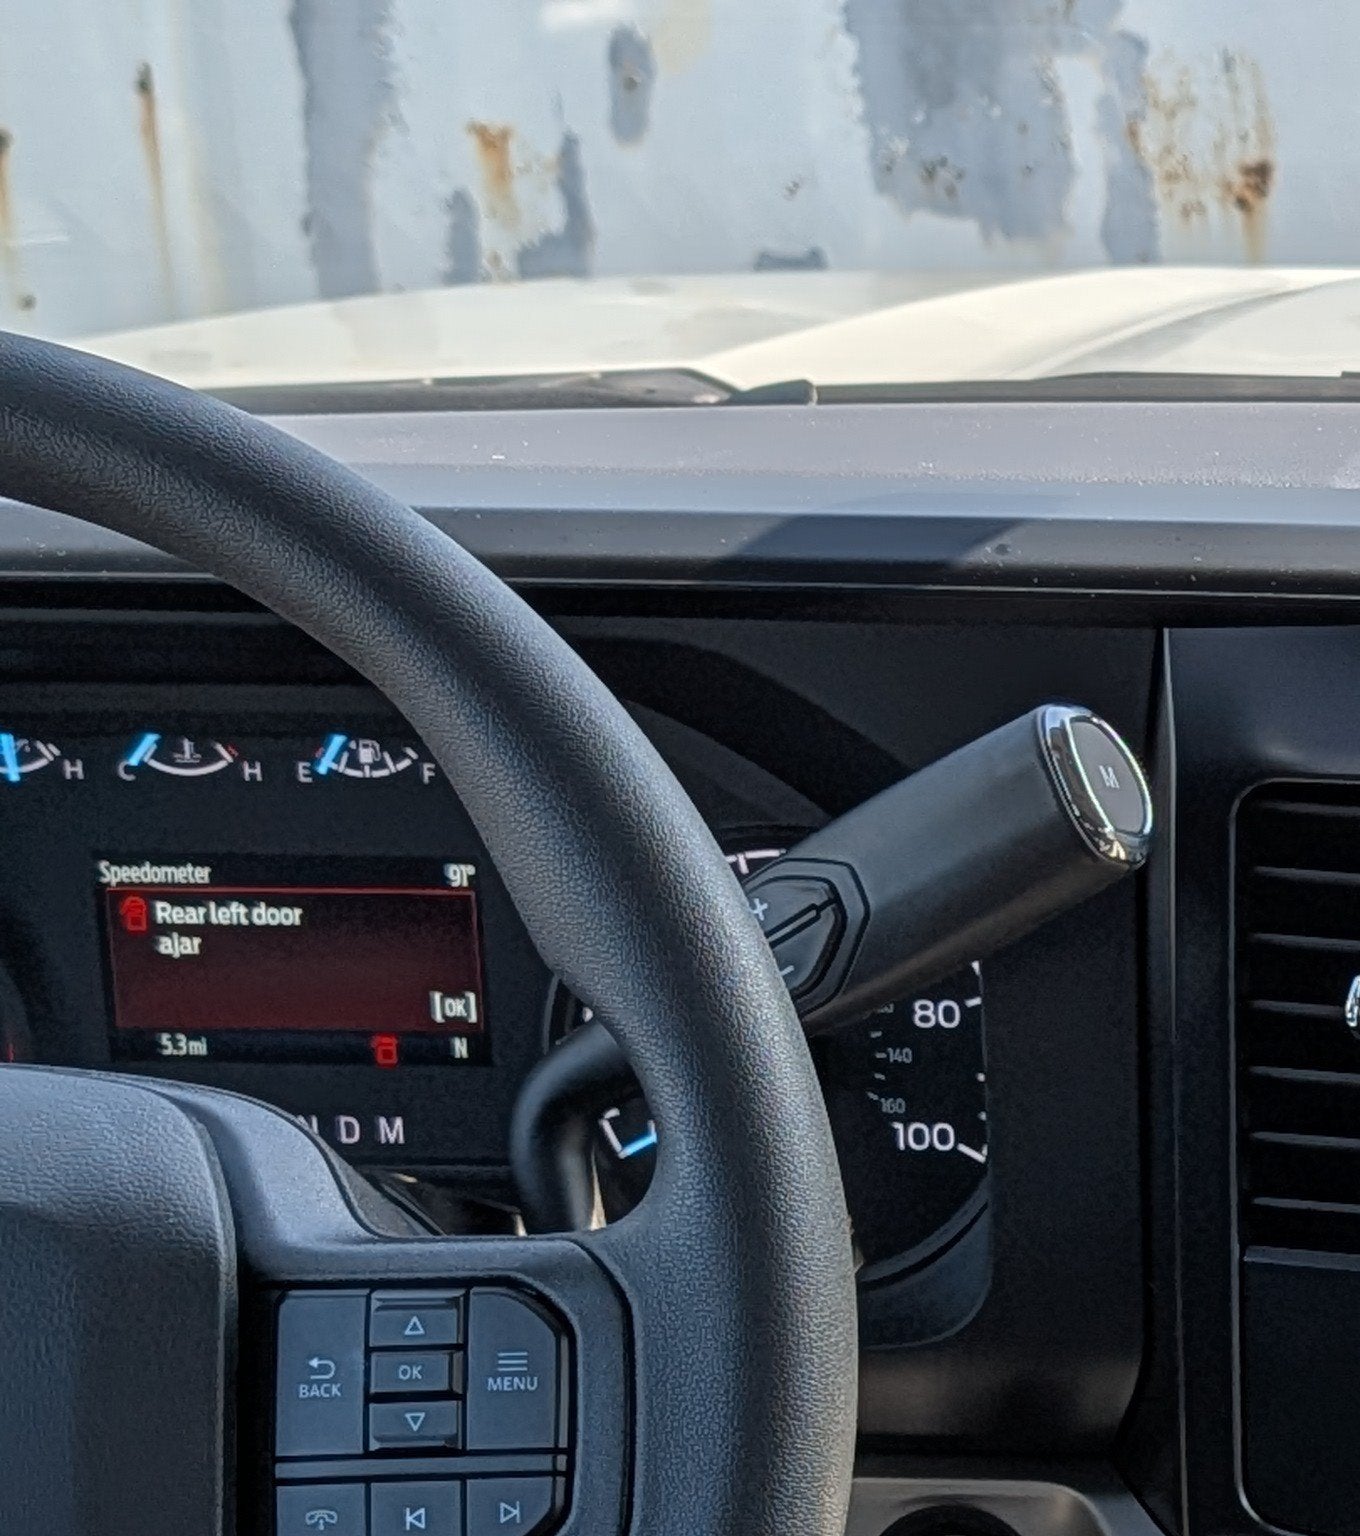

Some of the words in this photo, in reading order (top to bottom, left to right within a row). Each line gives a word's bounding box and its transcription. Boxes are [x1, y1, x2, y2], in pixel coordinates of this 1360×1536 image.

[243, 762, 262, 782] H
[298, 762, 313, 783] E
[422, 763, 436, 784] F
[99, 862, 211, 887] Speedometer
[155, 902, 207, 926] Rear
[208, 902, 249, 927] left
[251, 904, 303, 927] door
[157, 933, 202, 959] ajar
[913, 1001, 962, 1029] 80
[453, 1037, 469, 1060] N
[337, 1116, 361, 1144] D
[378, 1116, 405, 1145] M
[892, 1124, 956, 1151] 100
[398, 1364, 423, 1382] OK
[487, 1376, 539, 1392] MENU
[299, 1383, 342, 1399] BACK
